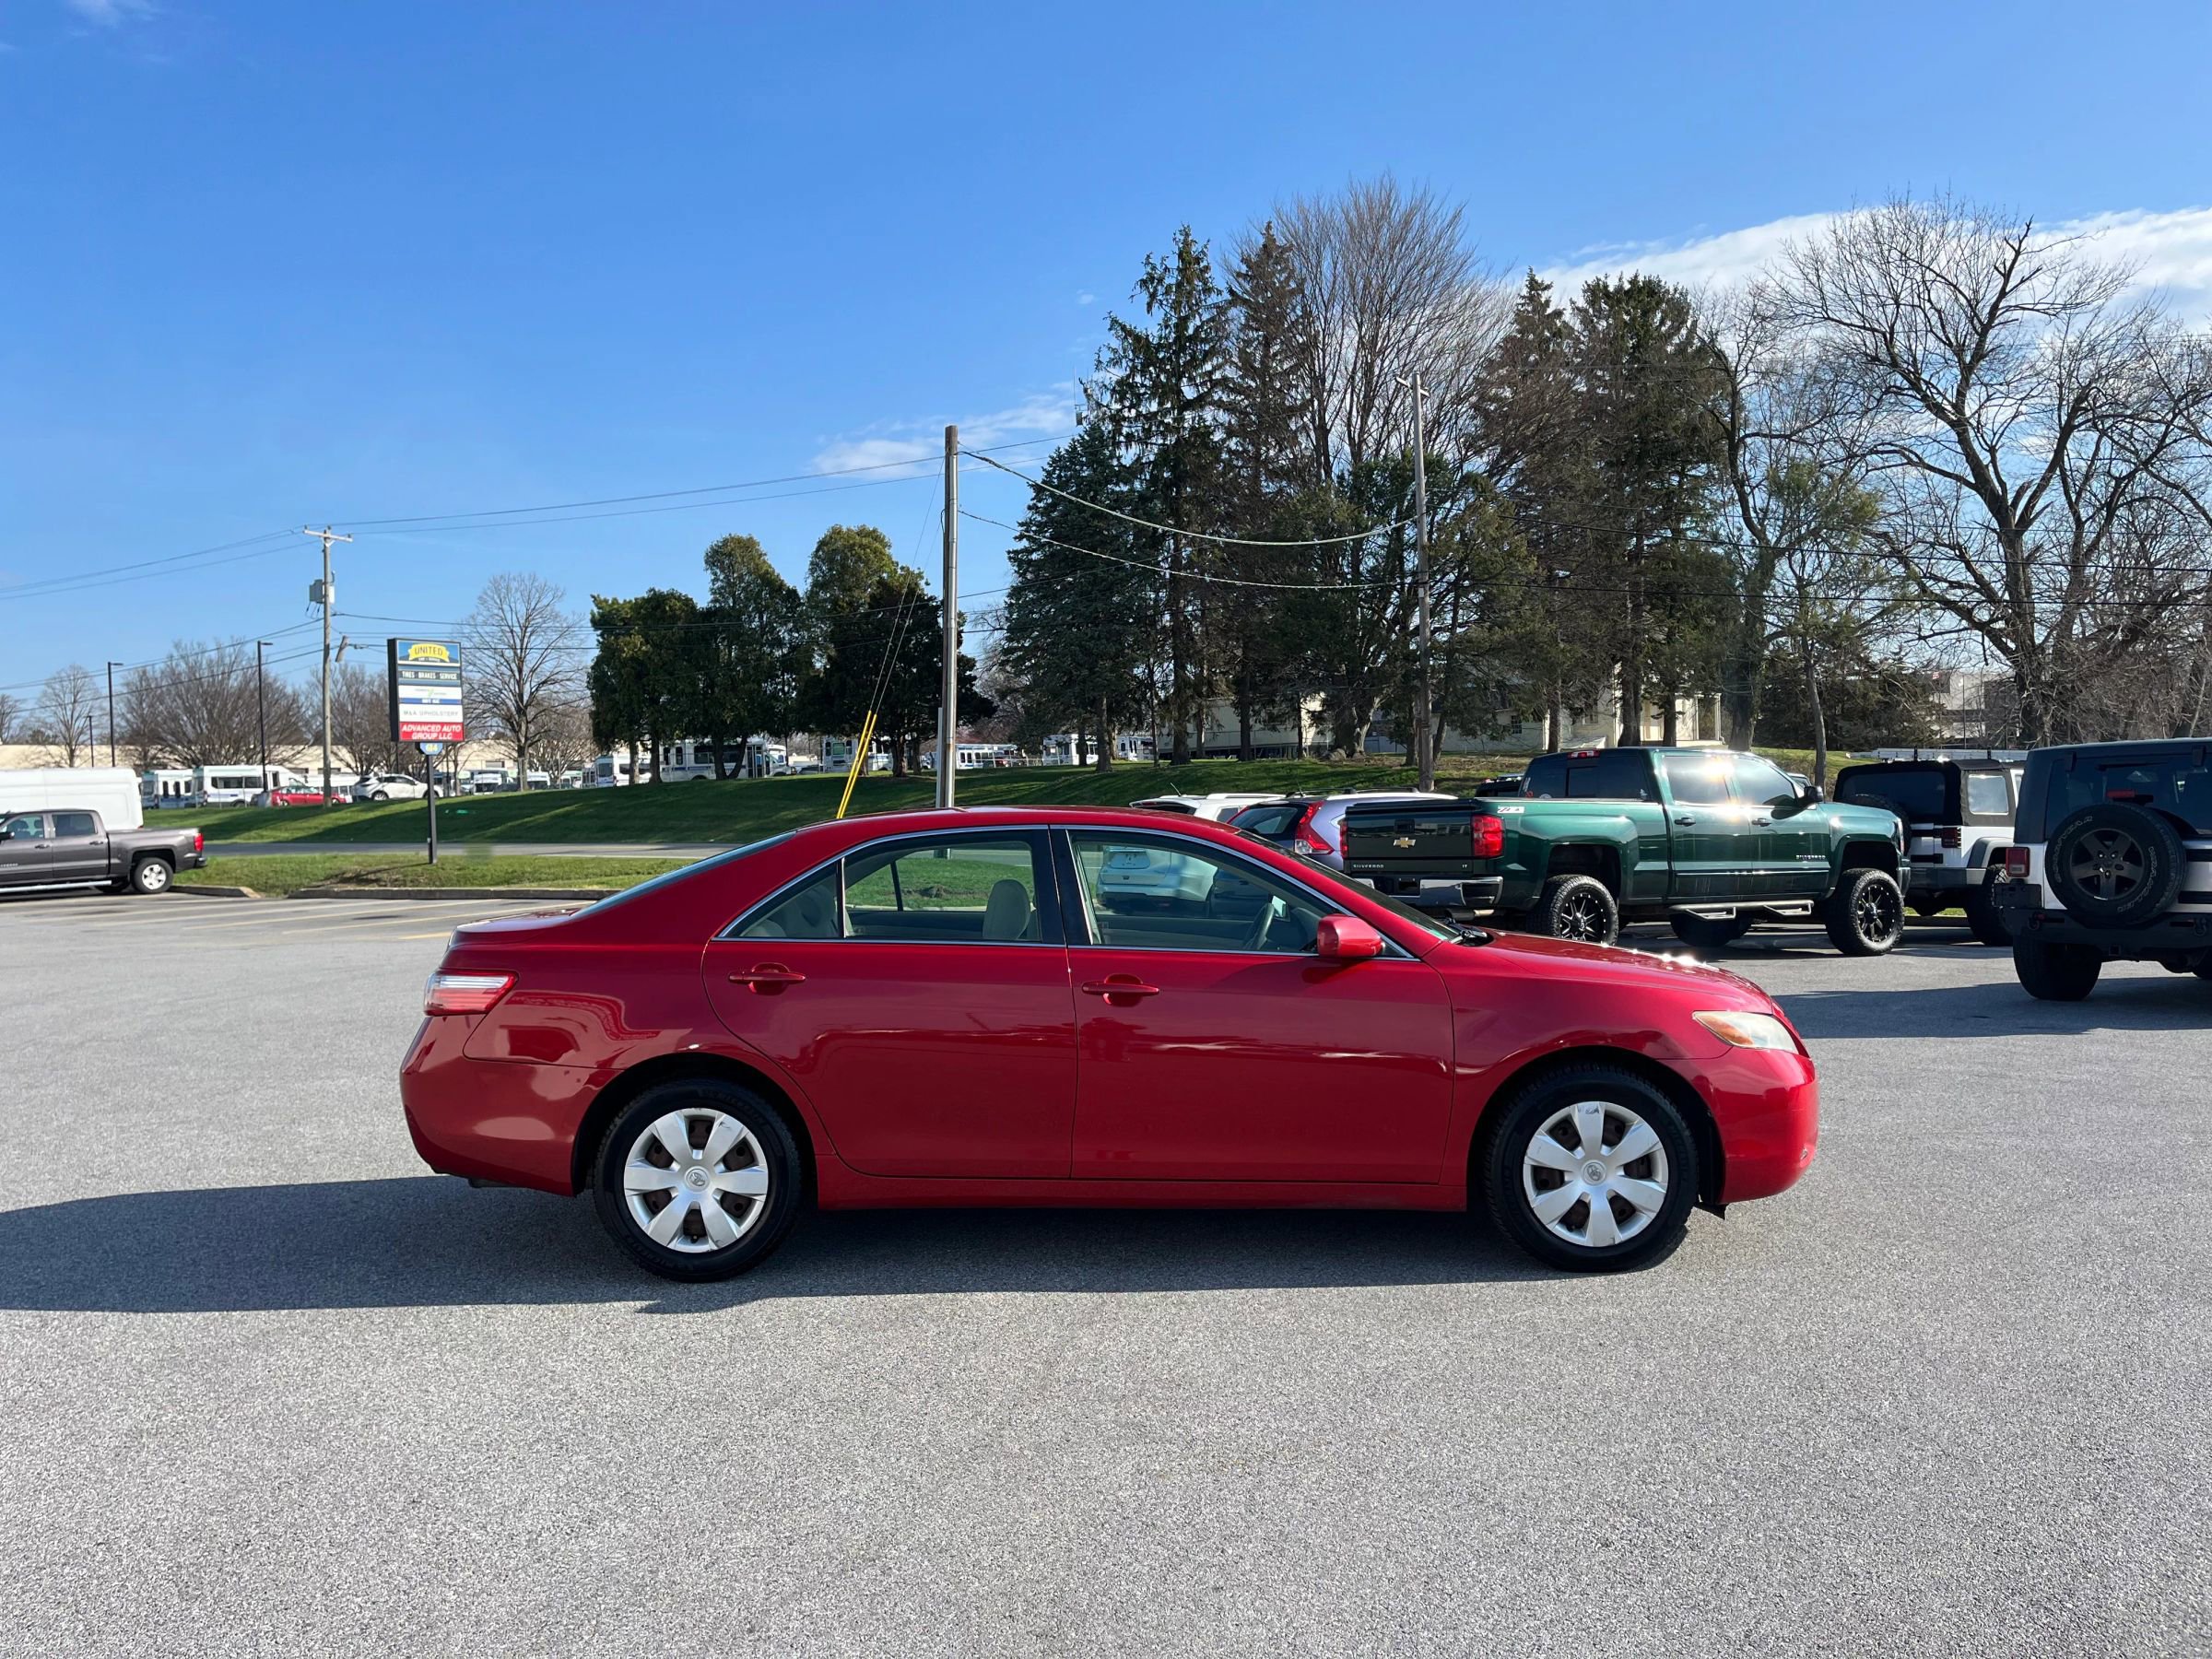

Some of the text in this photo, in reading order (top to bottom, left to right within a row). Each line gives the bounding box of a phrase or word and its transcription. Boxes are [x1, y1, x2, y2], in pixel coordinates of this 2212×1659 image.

[414, 646, 443, 656] UNITED
[402, 724, 462, 733] ADVANCED AUTO
[412, 732, 453, 740] GROUP LLC
